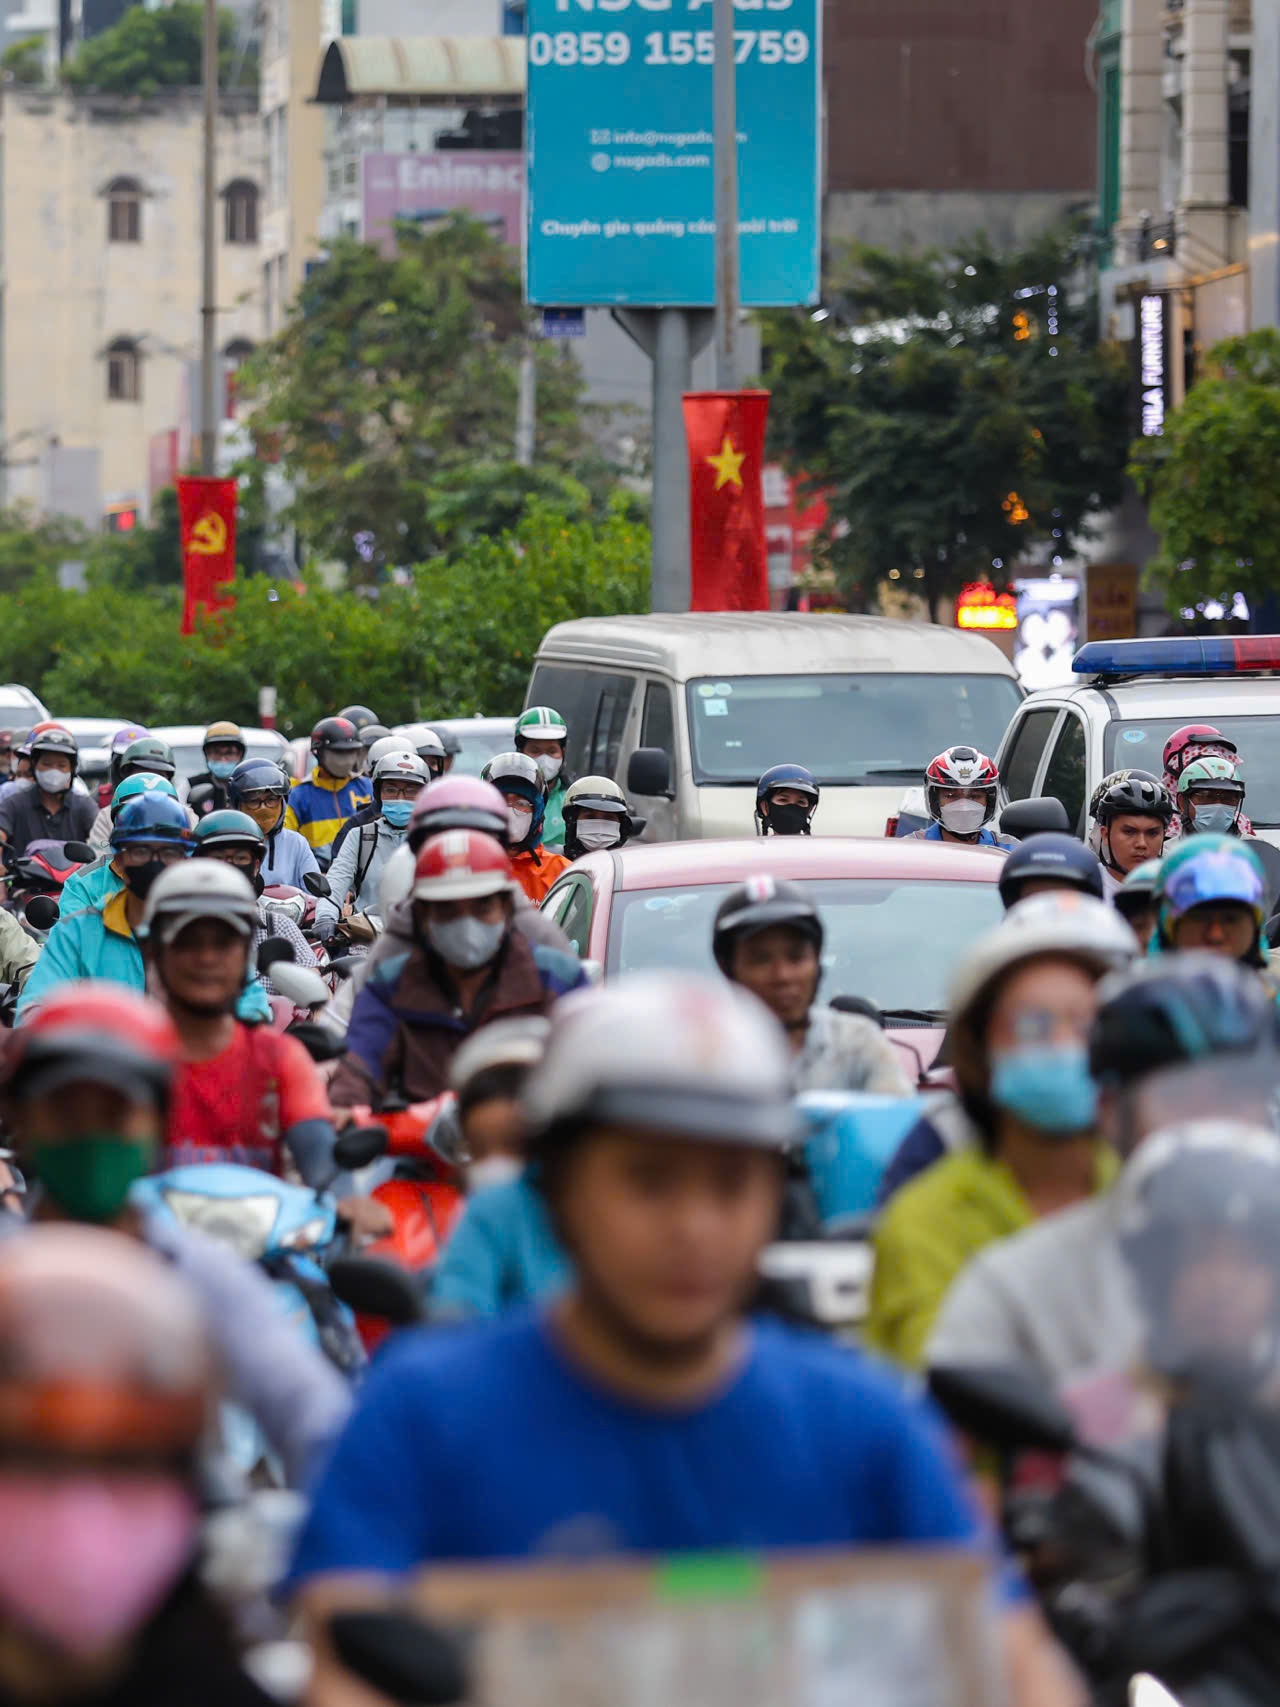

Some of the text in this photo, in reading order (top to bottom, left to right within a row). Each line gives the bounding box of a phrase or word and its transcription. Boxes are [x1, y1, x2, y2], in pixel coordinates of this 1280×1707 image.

[529, 30, 810, 66] 0859 155 759
